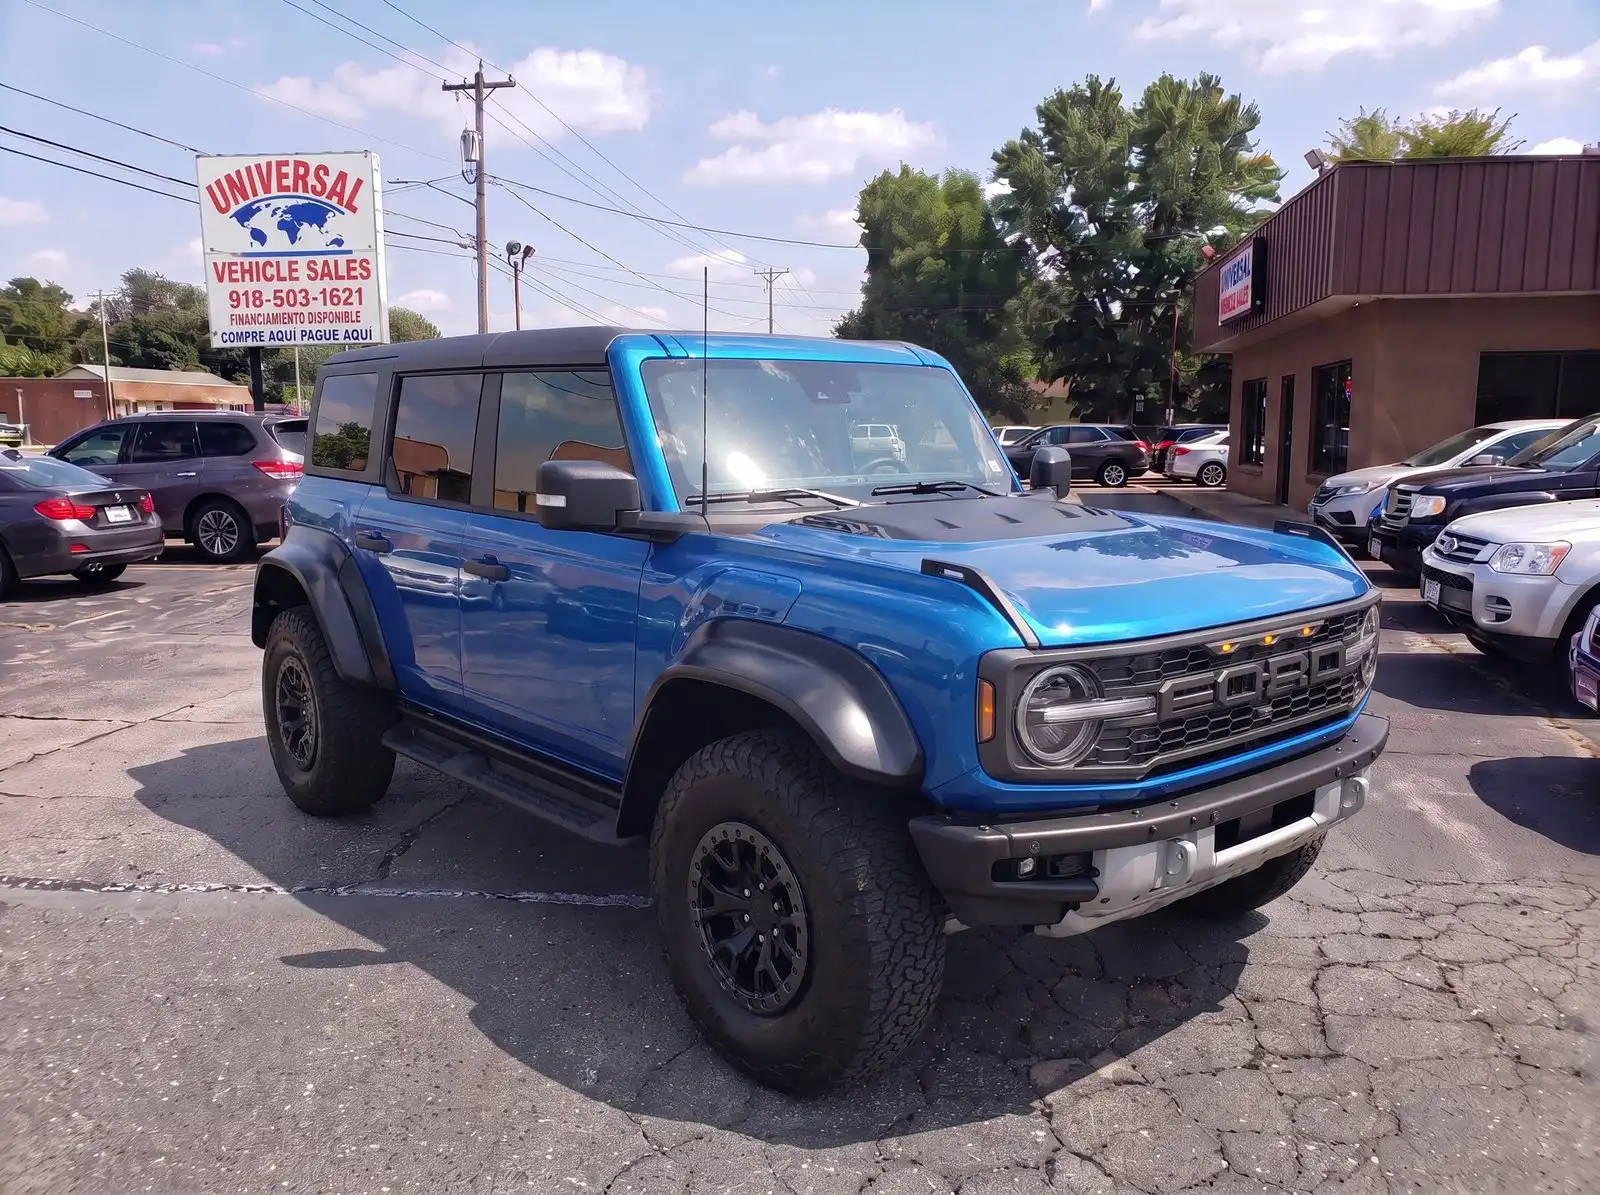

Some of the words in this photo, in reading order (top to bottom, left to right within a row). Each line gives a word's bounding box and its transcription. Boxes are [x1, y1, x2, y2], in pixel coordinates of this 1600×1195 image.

[206, 160, 364, 214] UNIVERSAL
[212, 260, 299, 283] VEHICLE
[306, 258, 371, 281] SALES
[228, 287, 363, 309] 918-503-1621
[230, 312, 305, 326] FINANCIAMIENTO
[308, 310, 361, 324] DISPONIBLE
[221, 330, 265, 343] COMPRE
[268, 327, 296, 342] AQUÍ
[301, 329, 340, 342] PAGUE
[343, 326, 373, 341] AQUÍ
[1158, 641, 1347, 721] FORD
